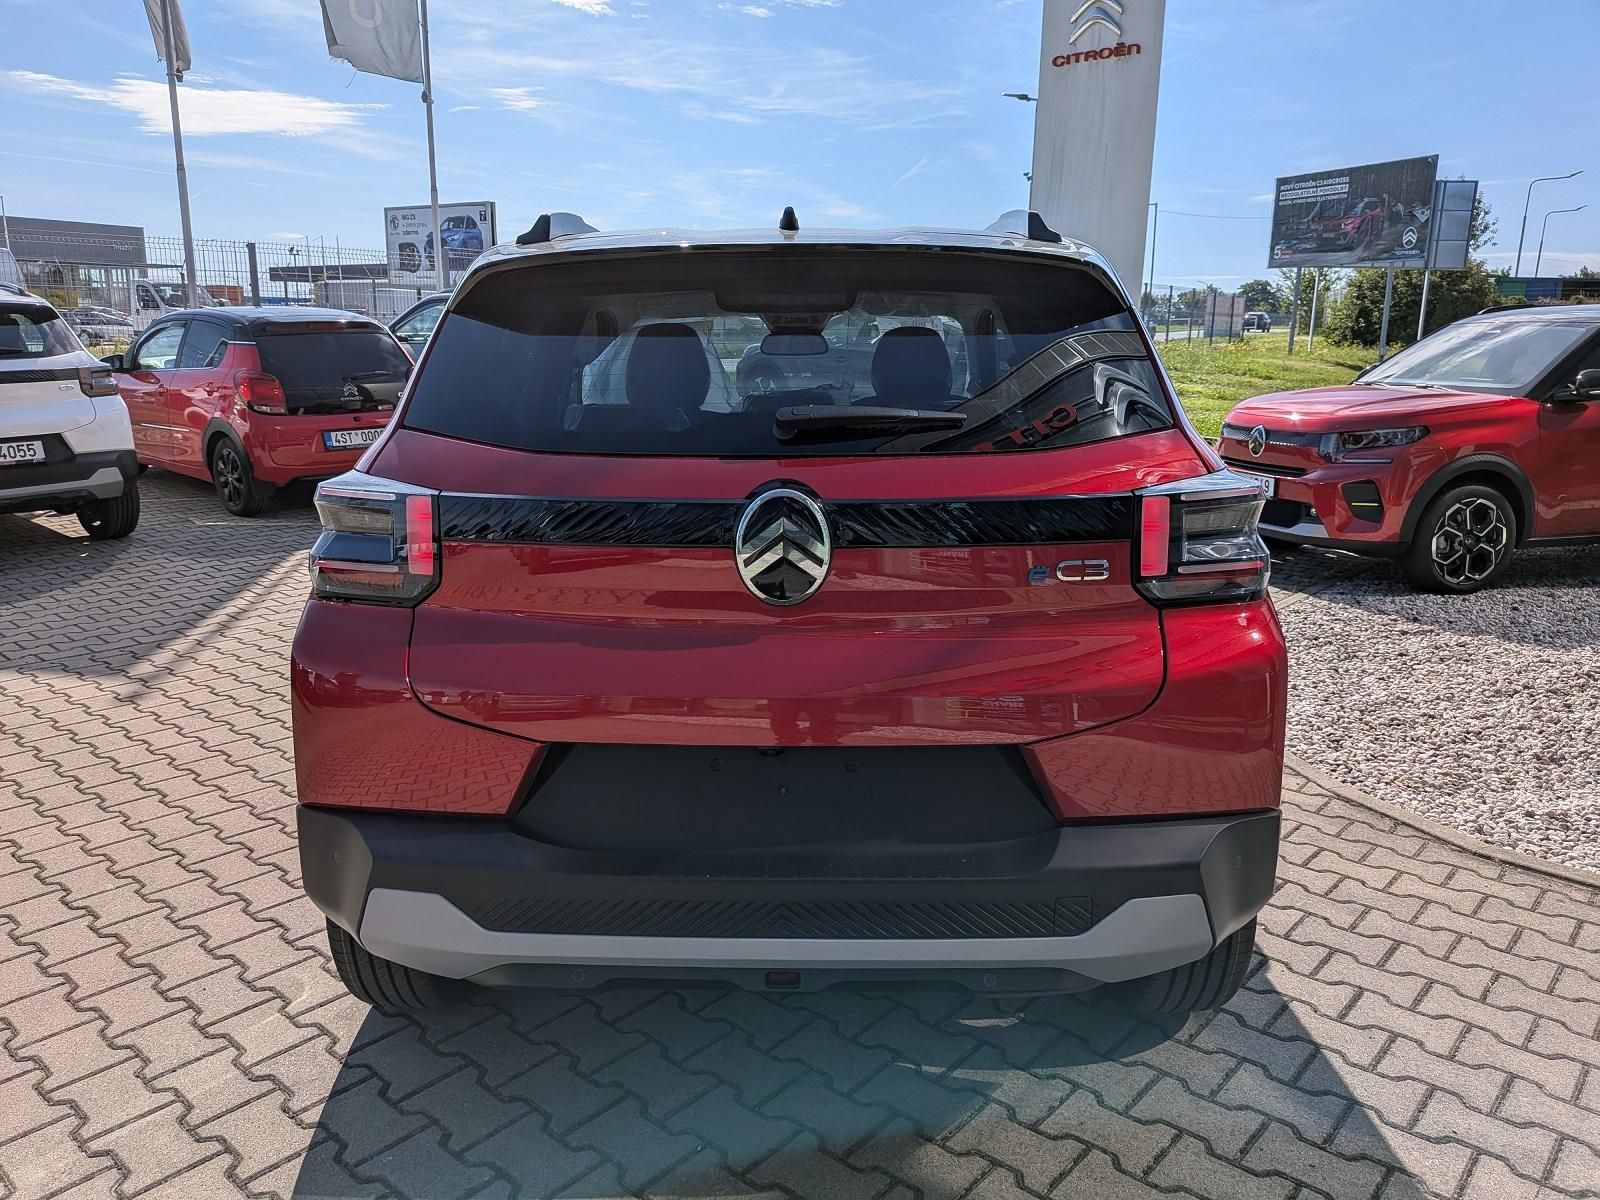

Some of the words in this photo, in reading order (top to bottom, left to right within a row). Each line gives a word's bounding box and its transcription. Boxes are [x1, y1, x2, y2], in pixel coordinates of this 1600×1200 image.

[1323, 176, 1350, 185] AIRCROSS
[1273, 245, 1281, 259] 5
[334, 432, 353, 445] 4ST
